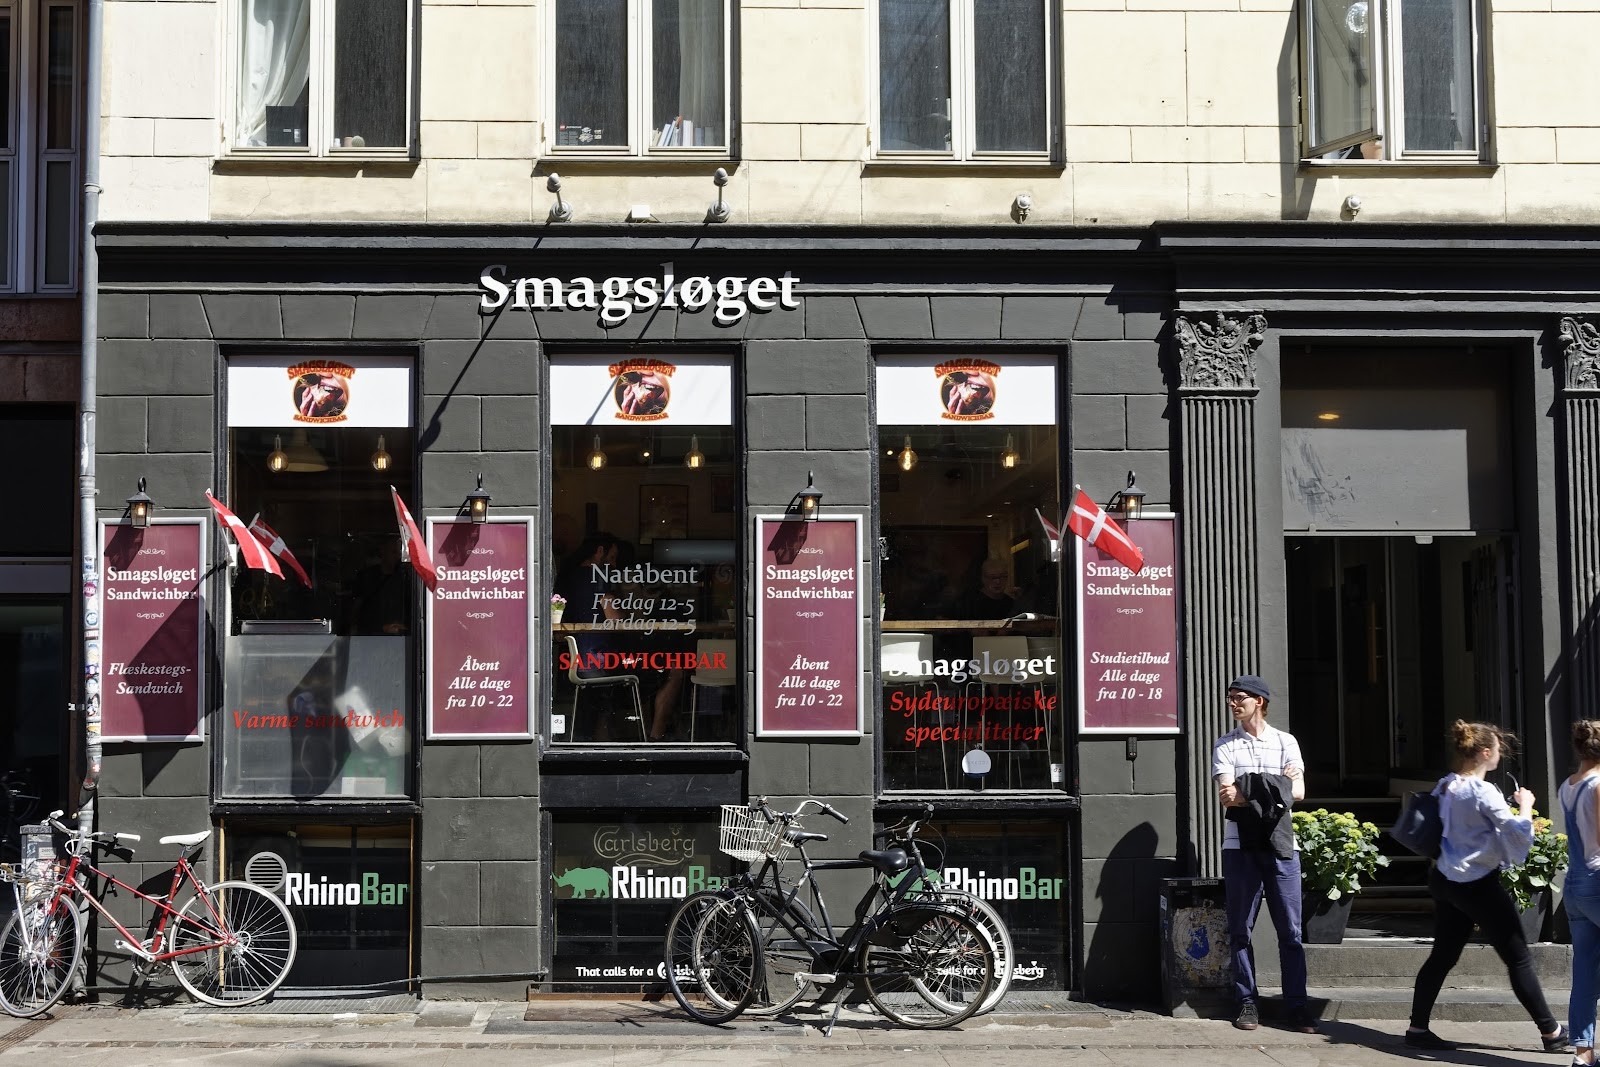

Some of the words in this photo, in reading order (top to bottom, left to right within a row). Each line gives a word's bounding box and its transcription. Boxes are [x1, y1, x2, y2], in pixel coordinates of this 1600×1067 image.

[480, 262, 801, 322] Smagsløget
[107, 566, 197, 584] Smagsløget
[436, 565, 525, 584] Smagsløget
[590, 562, 699, 584] Natåbent
[766, 565, 854, 583] Smagsløget
[1086, 562, 1173, 580] Smagsøget
[107, 588, 197, 600] Sandwichbar
[436, 587, 525, 600] Sandwichbar
[766, 586, 854, 599] Sandwichbar
[1087, 583, 1173, 596] Sandwichbar
[591, 592, 655, 615] Fredag
[659, 598, 695, 616] 12-5
[591, 613, 655, 635] Lørdag
[658, 619, 697, 636] 12-5
[460, 655, 500, 671] Åbent
[559, 652, 728, 671] SANDWICHBAR
[790, 654, 829, 670] Åbent
[1090, 651, 1170, 665] Studietilbud
[108, 662, 192, 678] Flæskestegs-
[1099, 669, 1127, 682] Alle
[1130, 669, 1160, 685] dage
[116, 682, 184, 695] Sandwich
[448, 677, 477, 689] Alle
[479, 677, 511, 692] dage
[778, 676, 807, 689] Alle
[809, 676, 841, 691] dage
[445, 695, 467, 710] fra
[470, 695, 485, 707] 10
[497, 695, 514, 707] 22
[775, 694, 796, 709] fra
[800, 694, 815, 706] 10
[827, 694, 843, 706] 22
[1096, 687, 1117, 702] fra
[1120, 687, 1135, 700] 10
[1148, 687, 1163, 700] 18
[890, 690, 1057, 717] Sydeuropæiske
[232, 710, 301, 729] Varme
[304, 709, 405, 729] sandwich
[905, 721, 1045, 748] specialiteter
[594, 825, 696, 859] Carlsberg
[285, 872, 410, 906] RhinoBar
[612, 865, 726, 899] RhinoBa
[944, 867, 1064, 900] RhinoBar
[575, 966, 601, 977] That
[603, 966, 627, 977] calls
[629, 965, 645, 977] for
[646, 968, 654, 977] a
[962, 965, 978, 976] for
